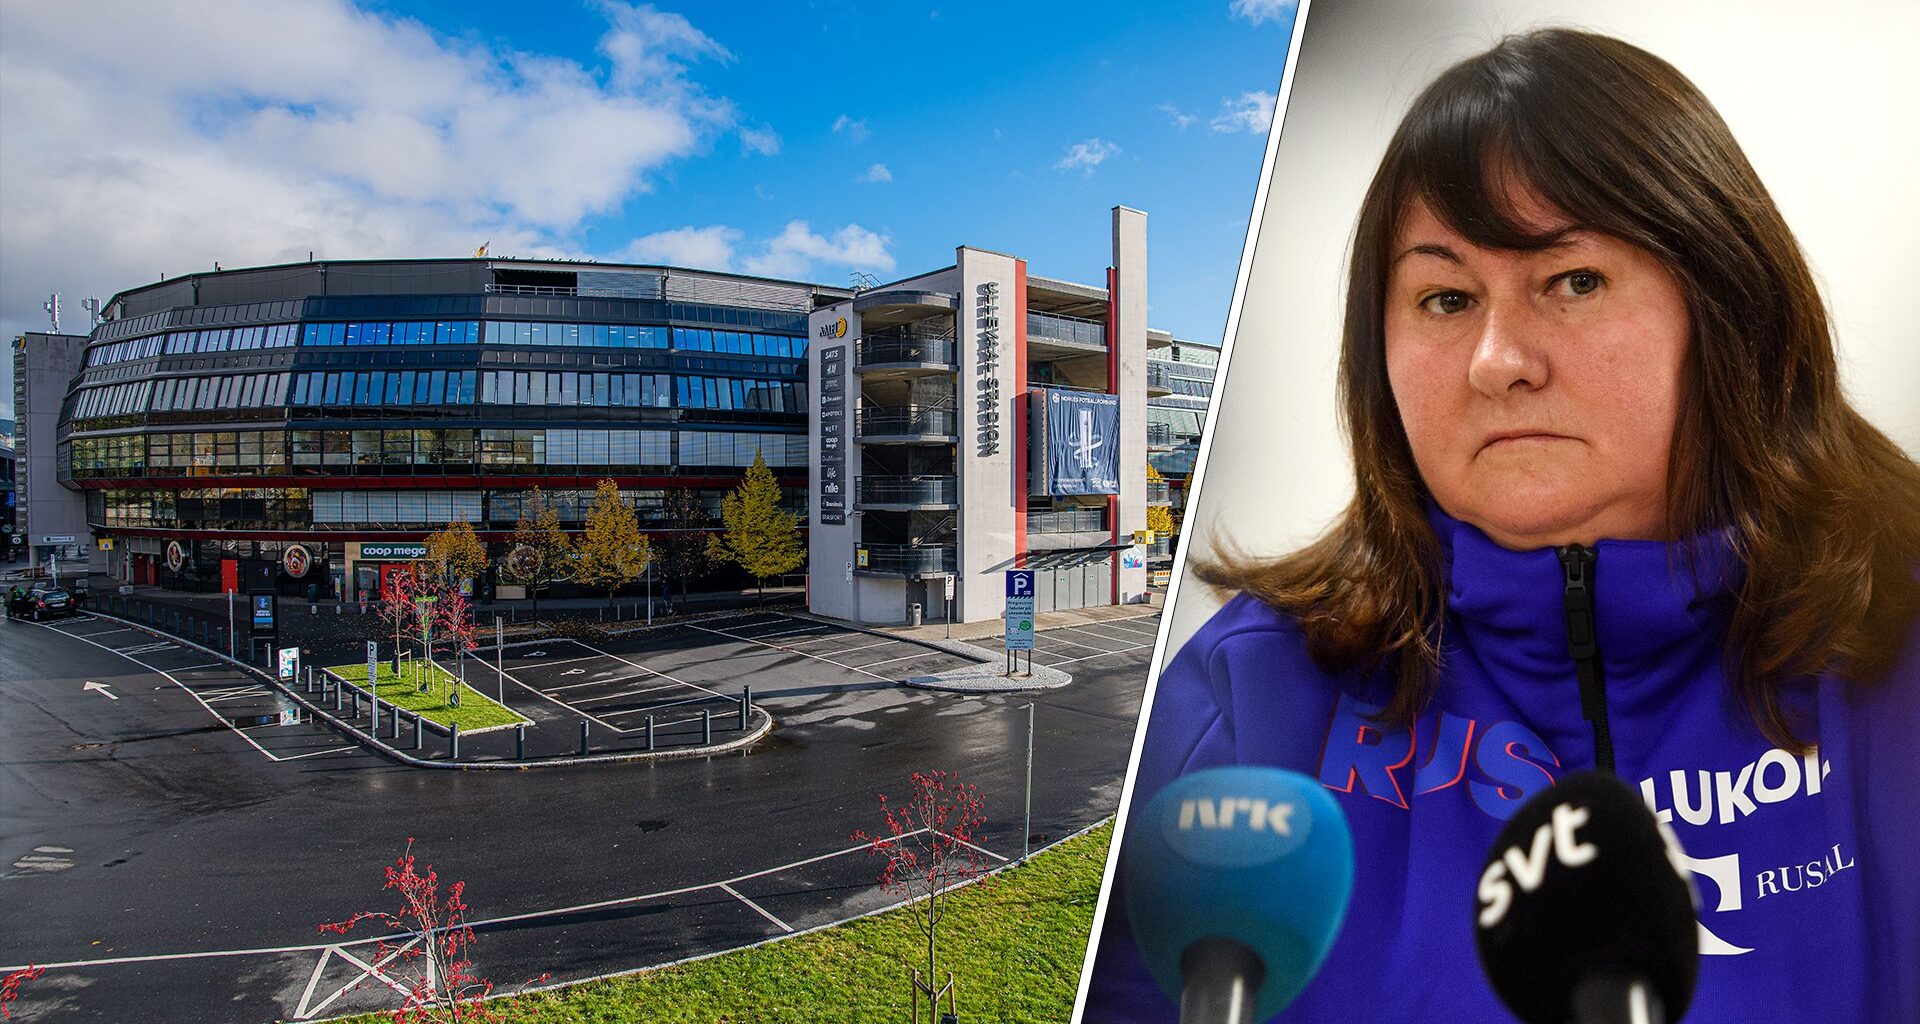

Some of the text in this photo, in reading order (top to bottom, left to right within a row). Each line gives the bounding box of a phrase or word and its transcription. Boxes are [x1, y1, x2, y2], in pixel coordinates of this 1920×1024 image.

[825, 350, 839, 360] SATS
[986, 282, 999, 455] ULLEVAAL STADION
[363, 547, 427, 558] coop mega
[947, 576, 952, 585] P
[1014, 578, 1028, 595] P
[369, 643, 375, 655] P
[1477, 802, 1599, 928] svt
[1755, 843, 1855, 900] RUSAL
